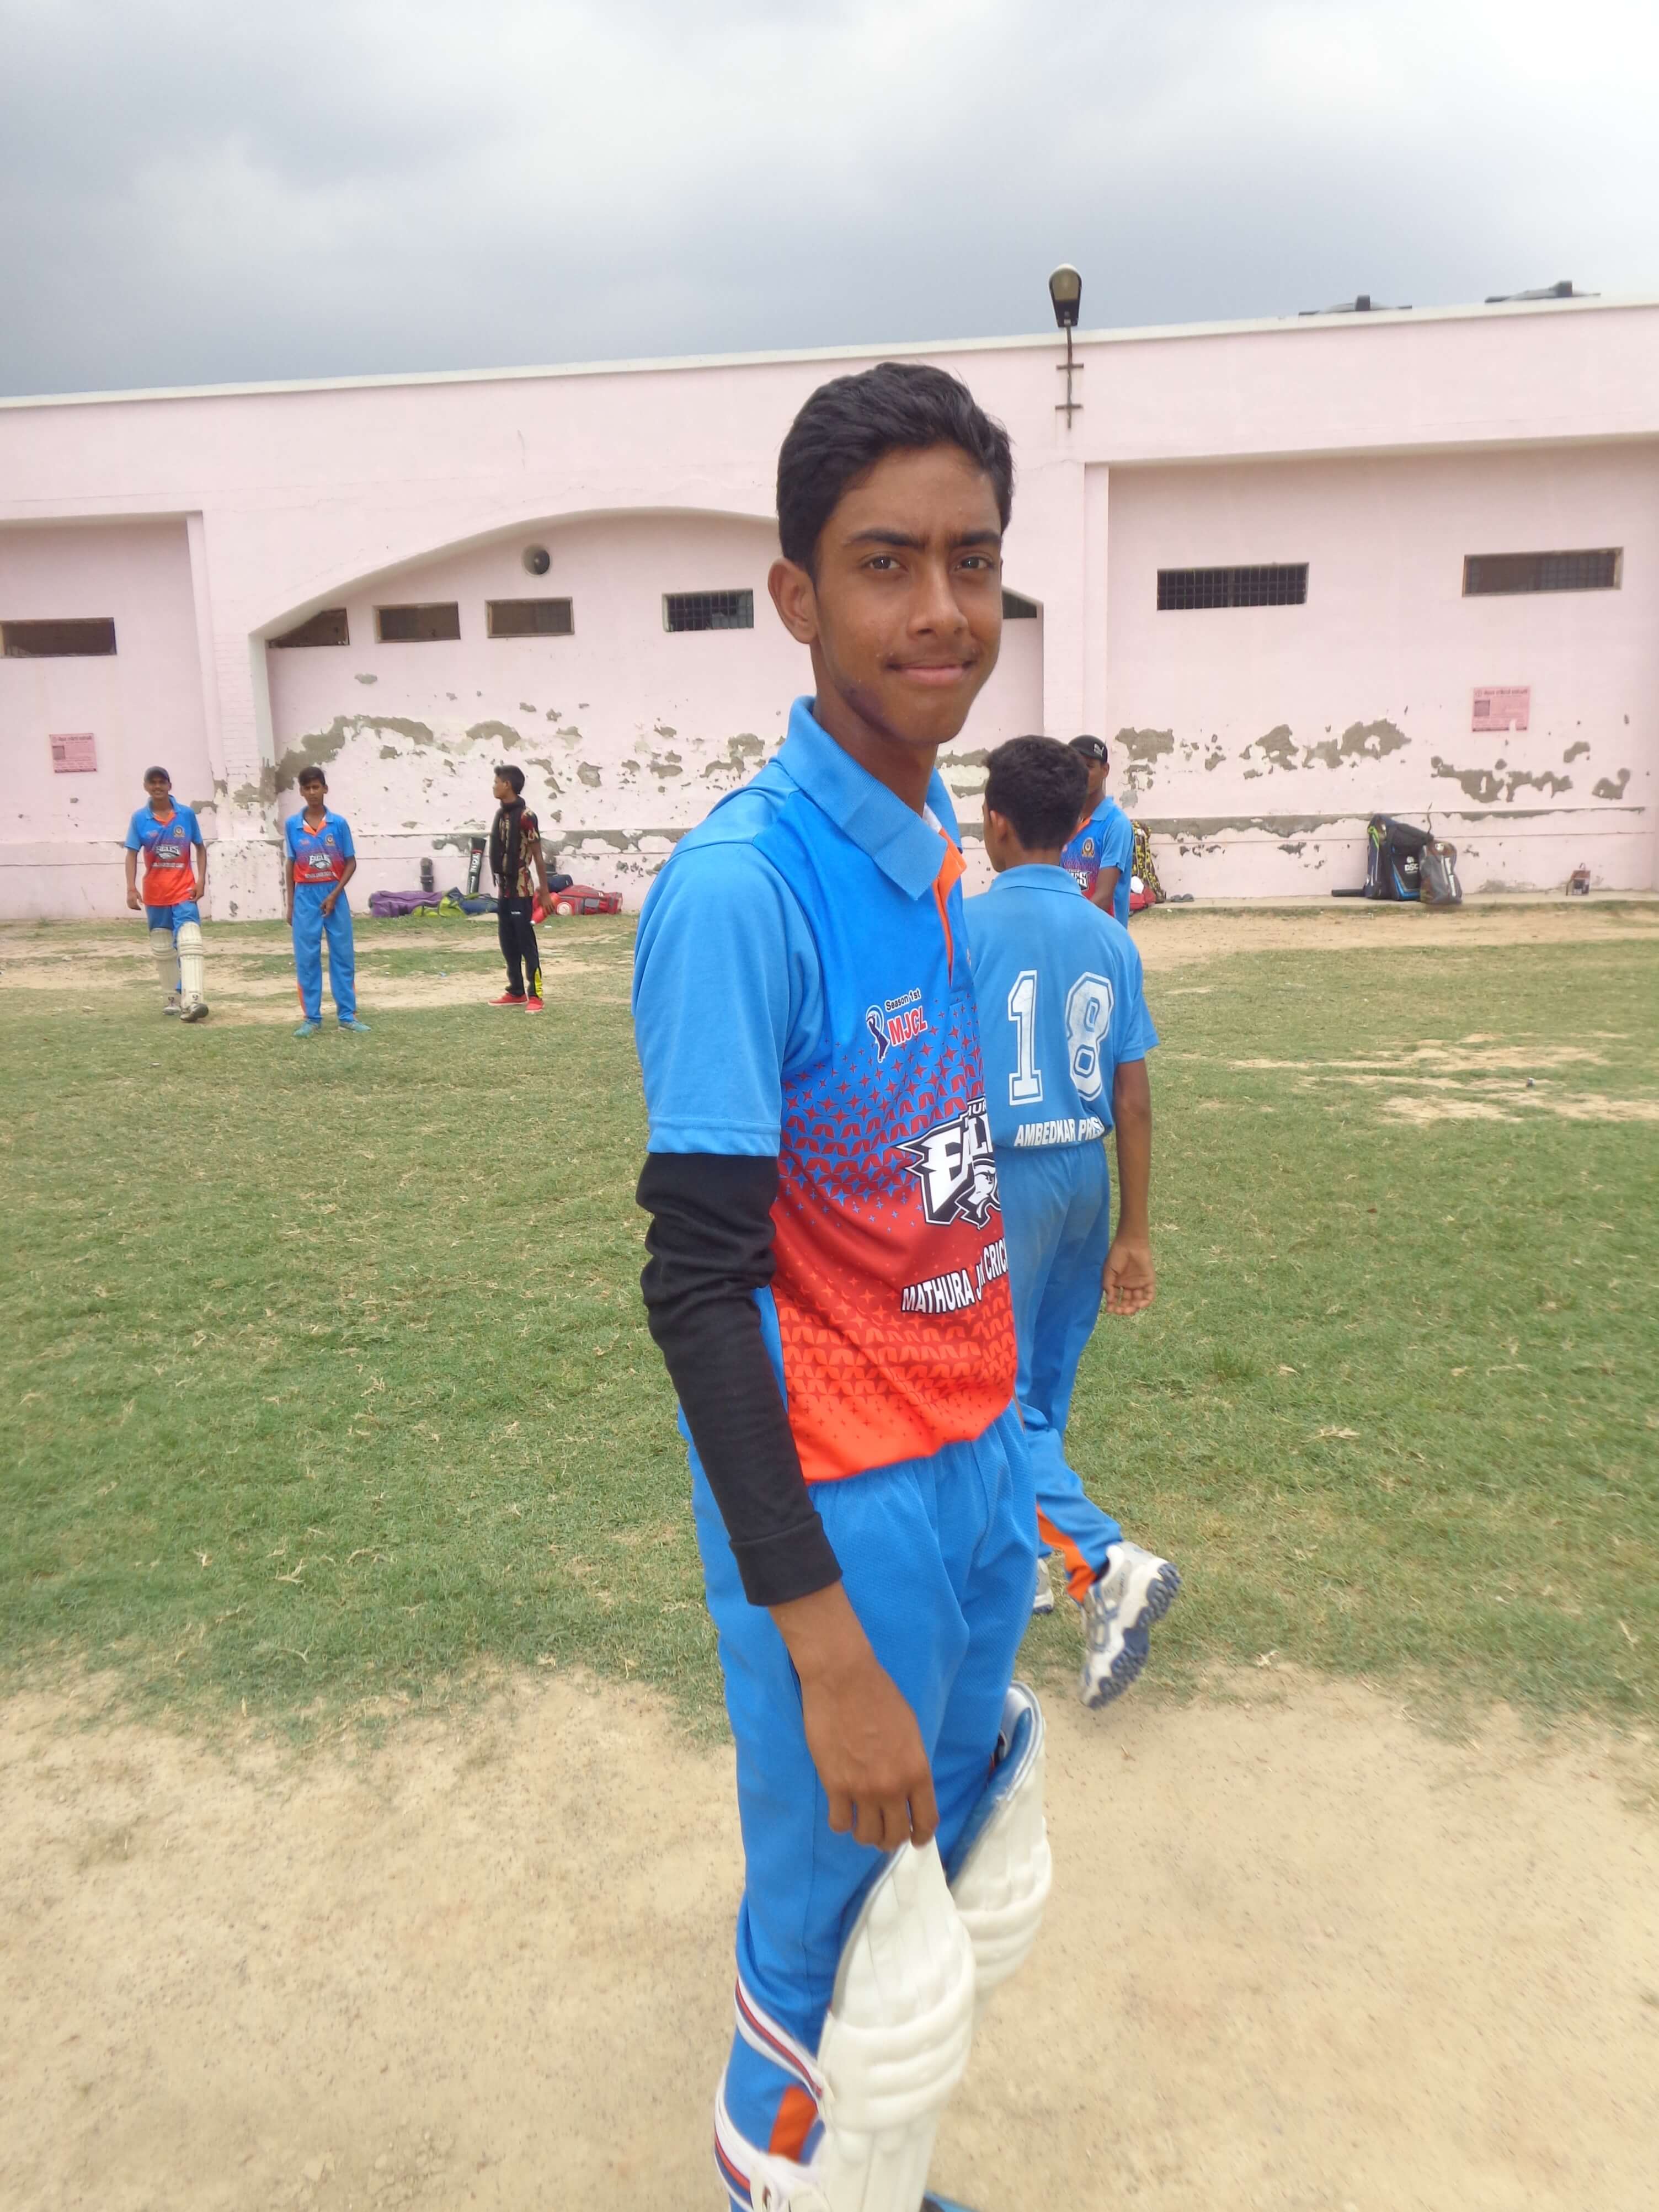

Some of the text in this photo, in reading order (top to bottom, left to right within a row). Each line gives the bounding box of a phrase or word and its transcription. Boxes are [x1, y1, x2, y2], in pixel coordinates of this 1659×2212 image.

[885, 989, 921, 1011] Season 1st
[888, 1006, 927, 1046] MJCL
[1007, 969, 1114, 1106] 18
[1013, 1118, 1076, 1147] AMBEDKAR
[901, 1270, 975, 1313] MATHURA
